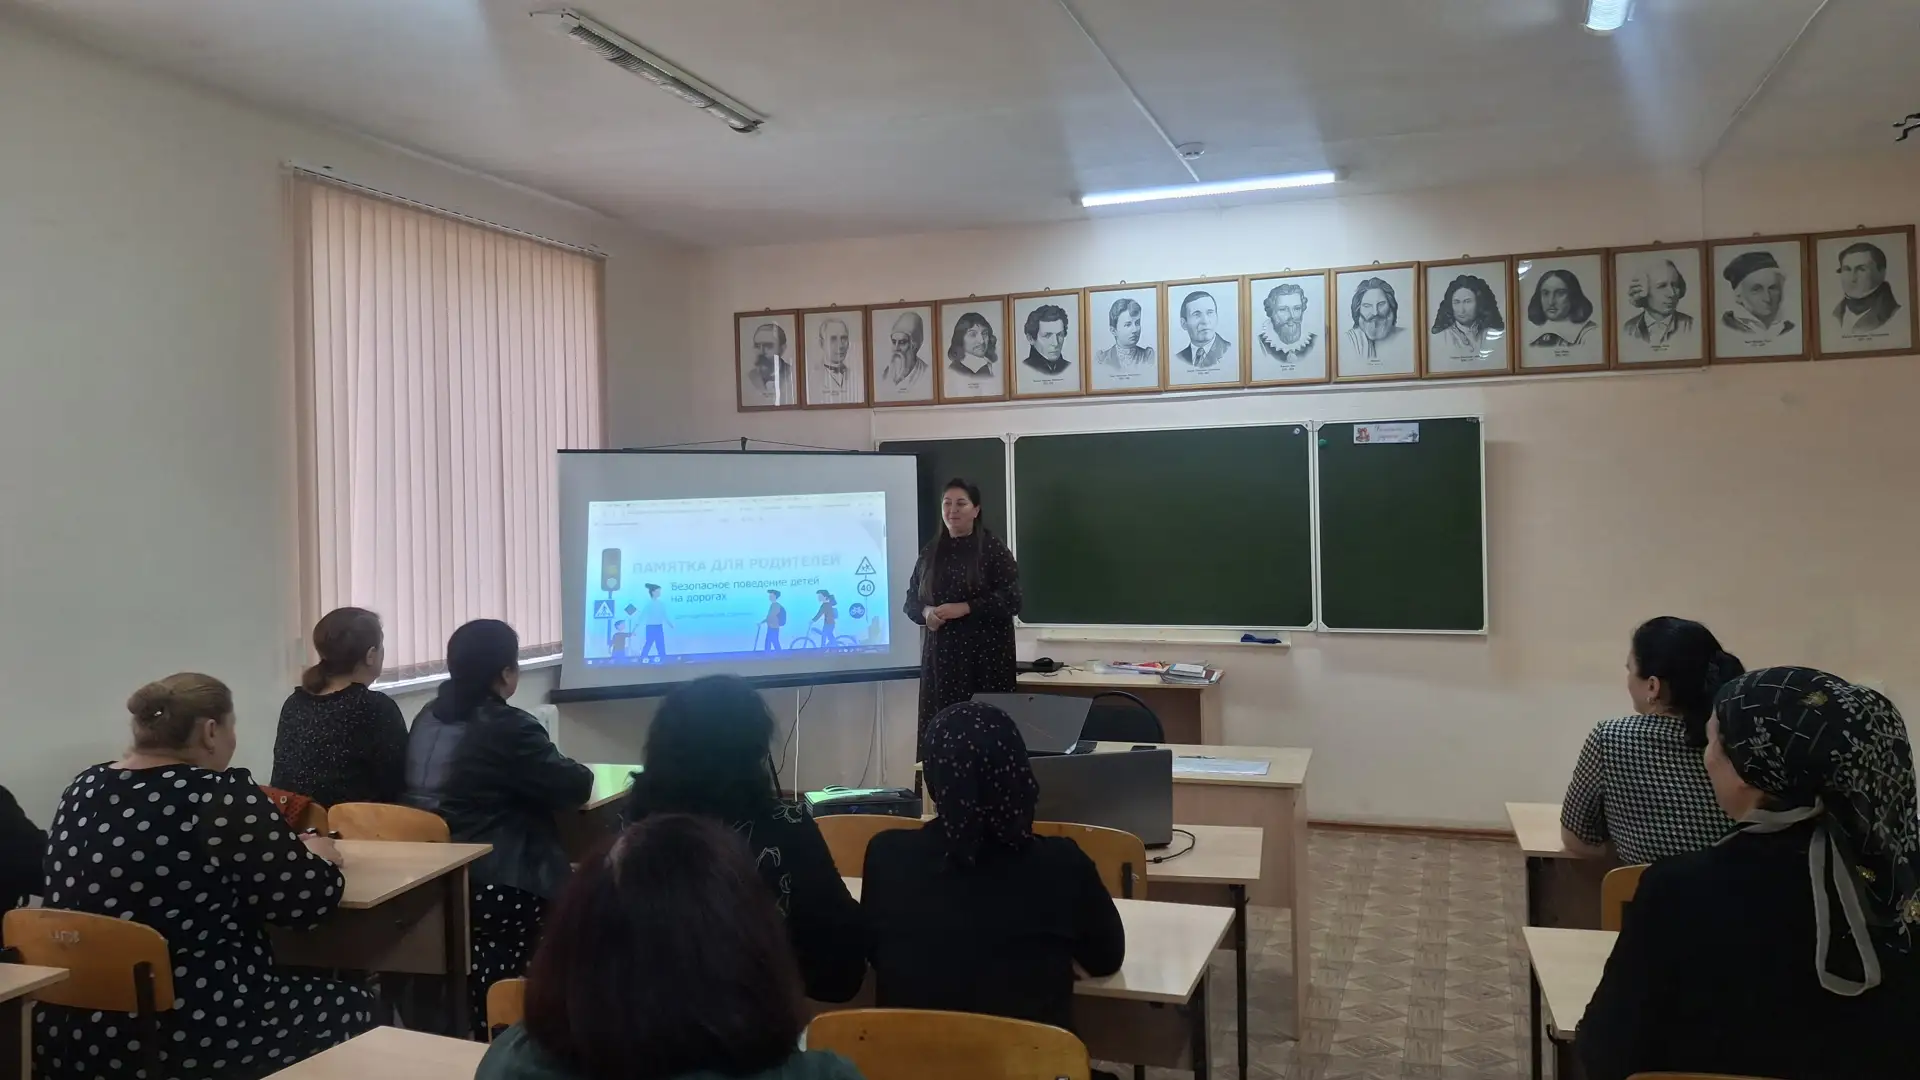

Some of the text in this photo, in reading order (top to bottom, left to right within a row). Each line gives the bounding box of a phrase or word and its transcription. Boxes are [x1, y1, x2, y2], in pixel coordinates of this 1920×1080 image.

[633, 553, 841, 574] ПАМЯТКА ДЛЯ РОДИТЕЛЕЙ
[671, 576, 820, 591] Безопасное поведение детей
[860, 584, 872, 592] 40
[671, 592, 728, 604] на дорогах
